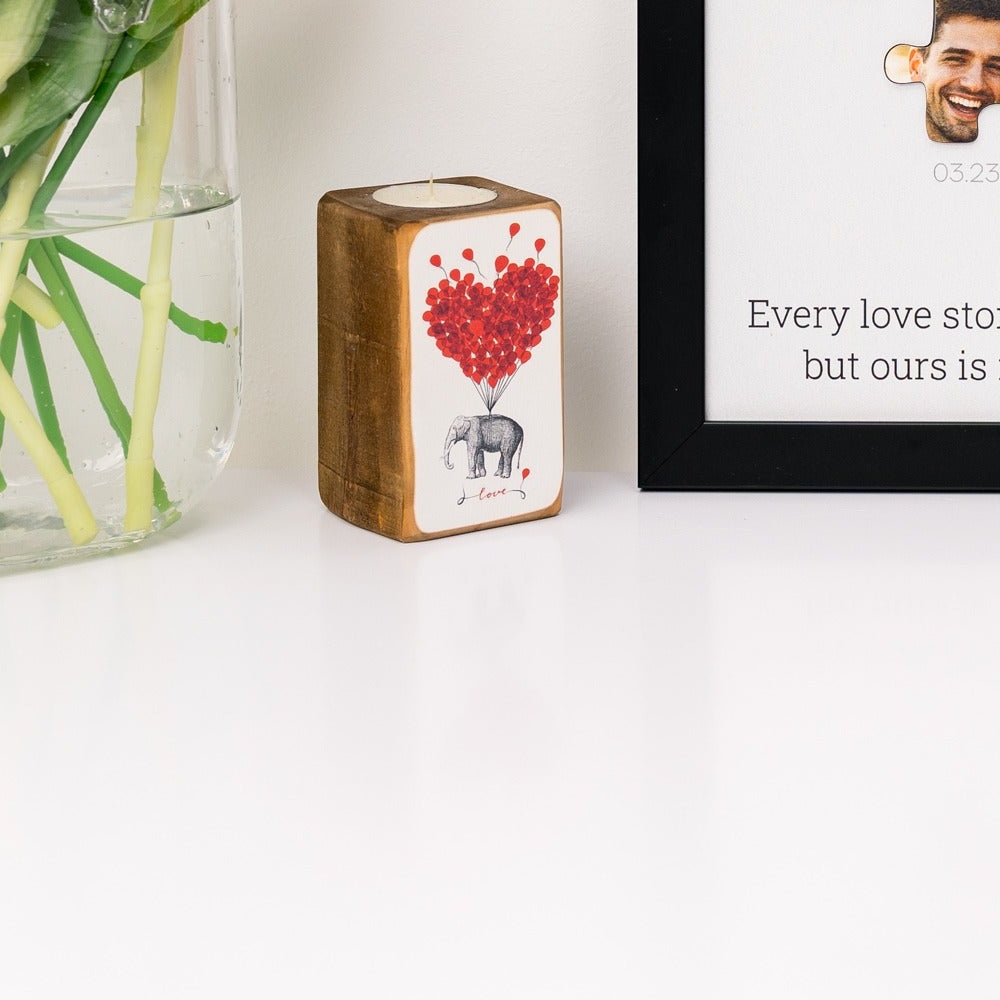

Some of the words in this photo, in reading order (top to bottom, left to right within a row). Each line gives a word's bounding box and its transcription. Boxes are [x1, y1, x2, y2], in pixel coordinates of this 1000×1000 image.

[748, 299, 850, 336] Every
[861, 298, 932, 330] love
[803, 349, 860, 380] but
[870, 358, 947, 381] ours
[959, 349, 987, 381] is
